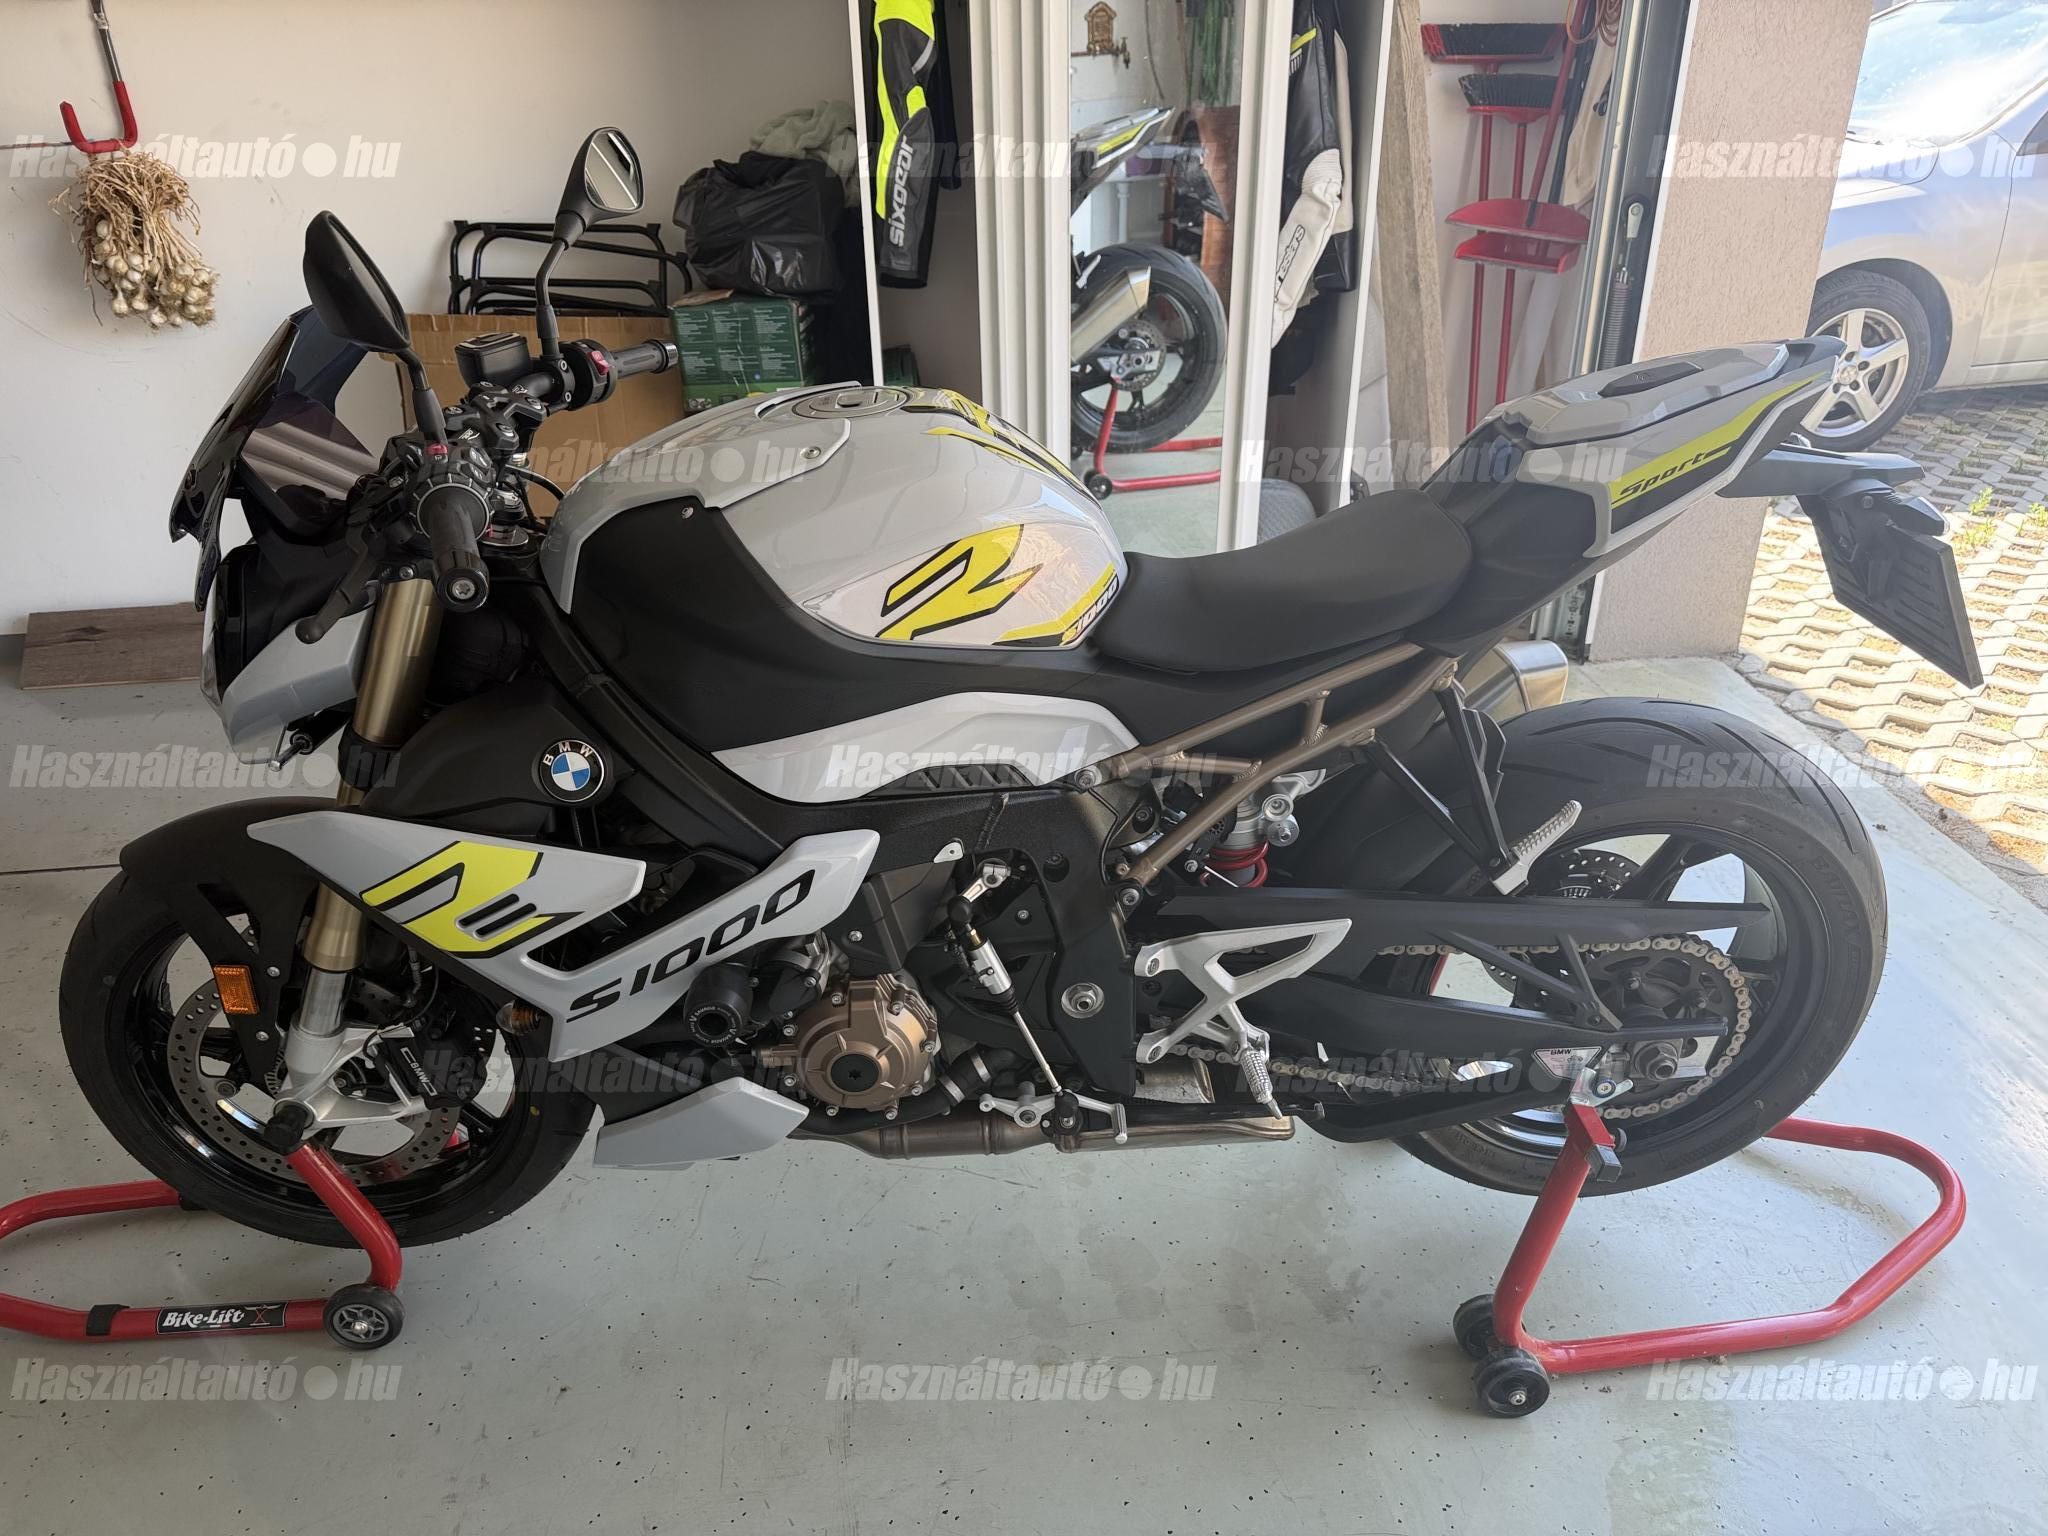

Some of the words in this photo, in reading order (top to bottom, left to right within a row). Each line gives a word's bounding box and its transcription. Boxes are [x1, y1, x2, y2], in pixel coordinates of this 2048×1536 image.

[1620, 450, 1708, 496] Sport
[542, 740, 594, 767] BMW
[566, 869, 815, 1024] S1000
[409, 1061, 431, 1084] BMW
[162, 1308, 245, 1329] Bike-Lift
